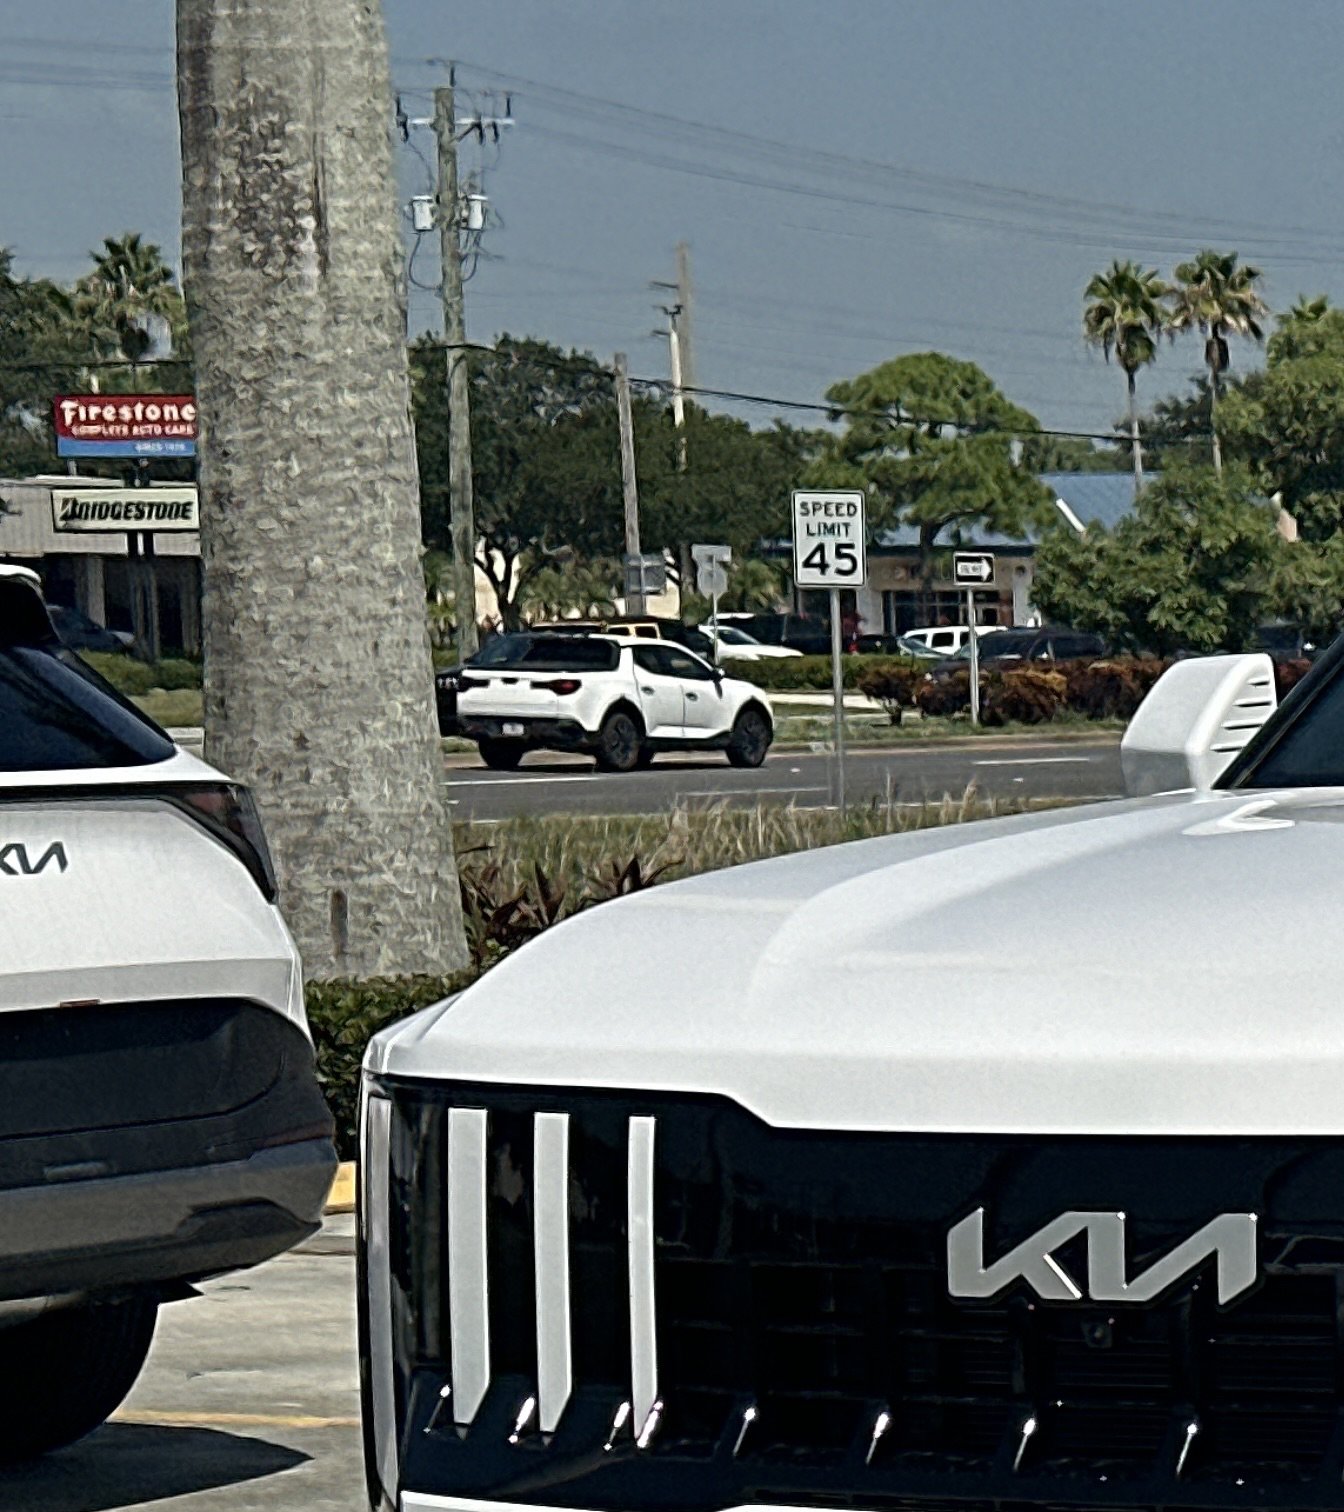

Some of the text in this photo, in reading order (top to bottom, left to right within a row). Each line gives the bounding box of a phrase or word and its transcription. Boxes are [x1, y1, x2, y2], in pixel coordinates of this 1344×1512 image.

[60, 400, 196, 426] Firestone
[60, 498, 194, 522] BRIDGESTONE
[799, 501, 858, 517] SPEED
[806, 522, 852, 537] LIMIT
[802, 542, 858, 576] 45
[946, 1206, 1257, 1305] KIA
